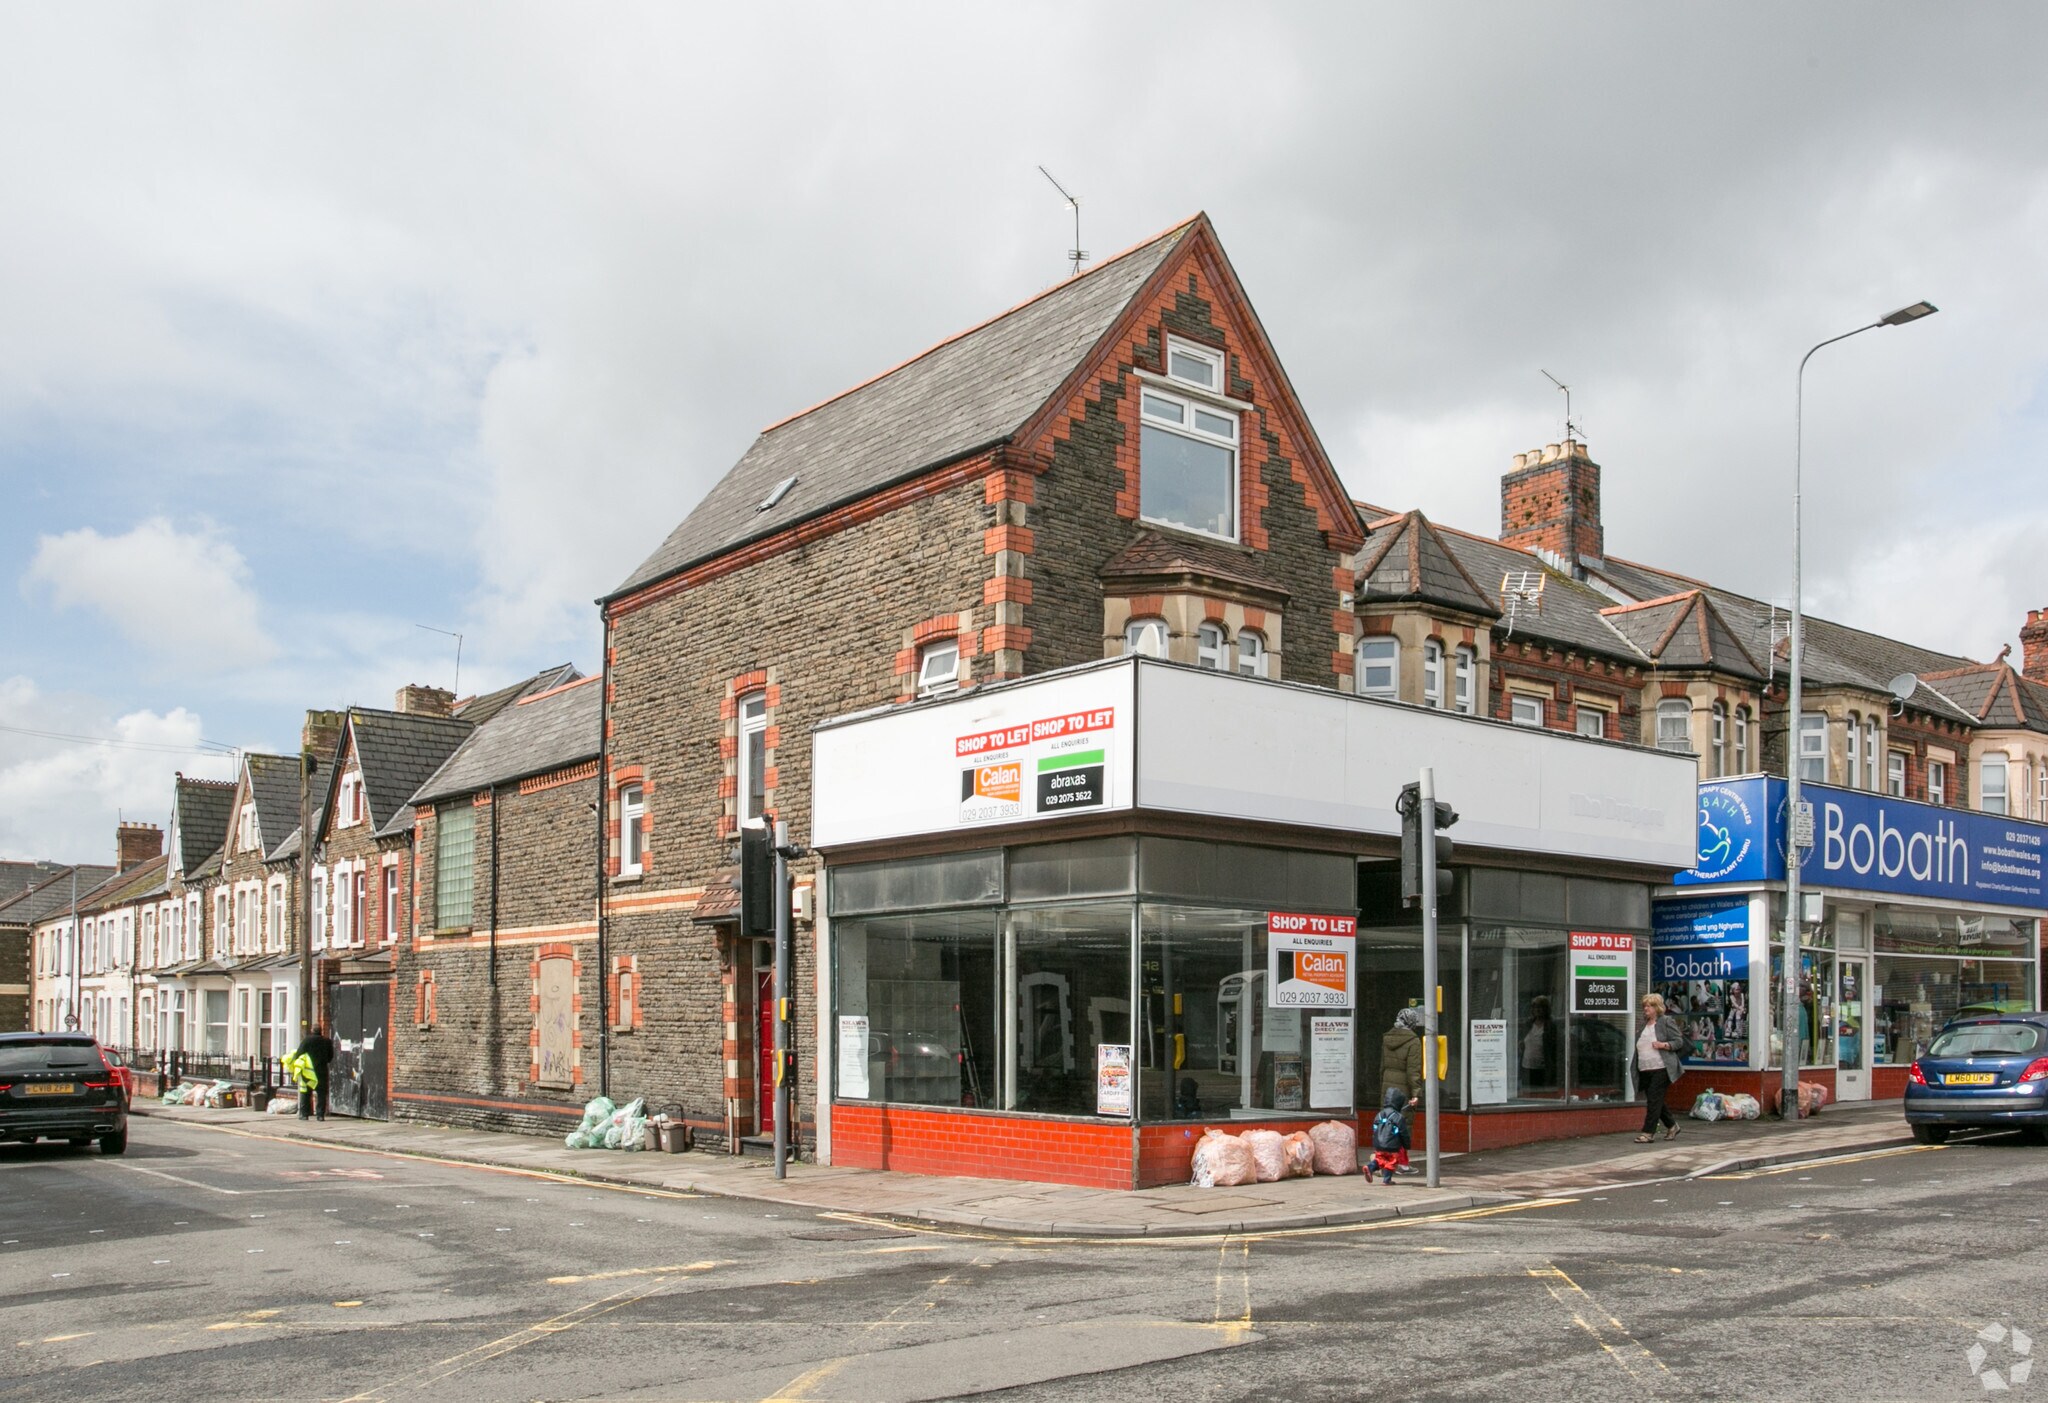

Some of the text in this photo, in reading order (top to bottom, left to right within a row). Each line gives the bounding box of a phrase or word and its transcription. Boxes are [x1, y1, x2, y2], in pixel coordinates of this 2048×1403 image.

[1034, 711, 1112, 737] SHOP TO LET
[957, 728, 1028, 753] SHOP TO LET
[1061, 738, 1089, 748] ENQUIRIES
[984, 752, 1009, 762] ENQUIRIES
[1051, 774, 1086, 789] abraxas
[1046, 791, 1092, 806] 029 2075 3622
[1720, 787, 1742, 804] CENTRE
[1740, 801, 1752, 825] WALES
[962, 803, 1019, 820] 029 2037 3933
[1824, 802, 1968, 885] Bobath
[2006, 831, 2015, 842] 029
[1694, 838, 1751, 879] THERAPI PLANT CYMRU
[1983, 846, 2040, 864] www.bobathwales.org
[1981, 860, 2040, 880] info@bobathwales.org
[1272, 915, 1353, 933] SHOP TO LET
[1707, 924, 1717, 932] yng
[1719, 923, 1744, 931] Nghymru
[1304, 938, 1333, 946] ENQUIRIES
[1572, 935, 1631, 948] SHOP TO LET
[1664, 952, 1731, 977] Bobath
[1588, 982, 1615, 993] abraxas
[1280, 992, 1345, 1004] 029 2037 3933
[1608, 998, 1619, 1006] 3622
